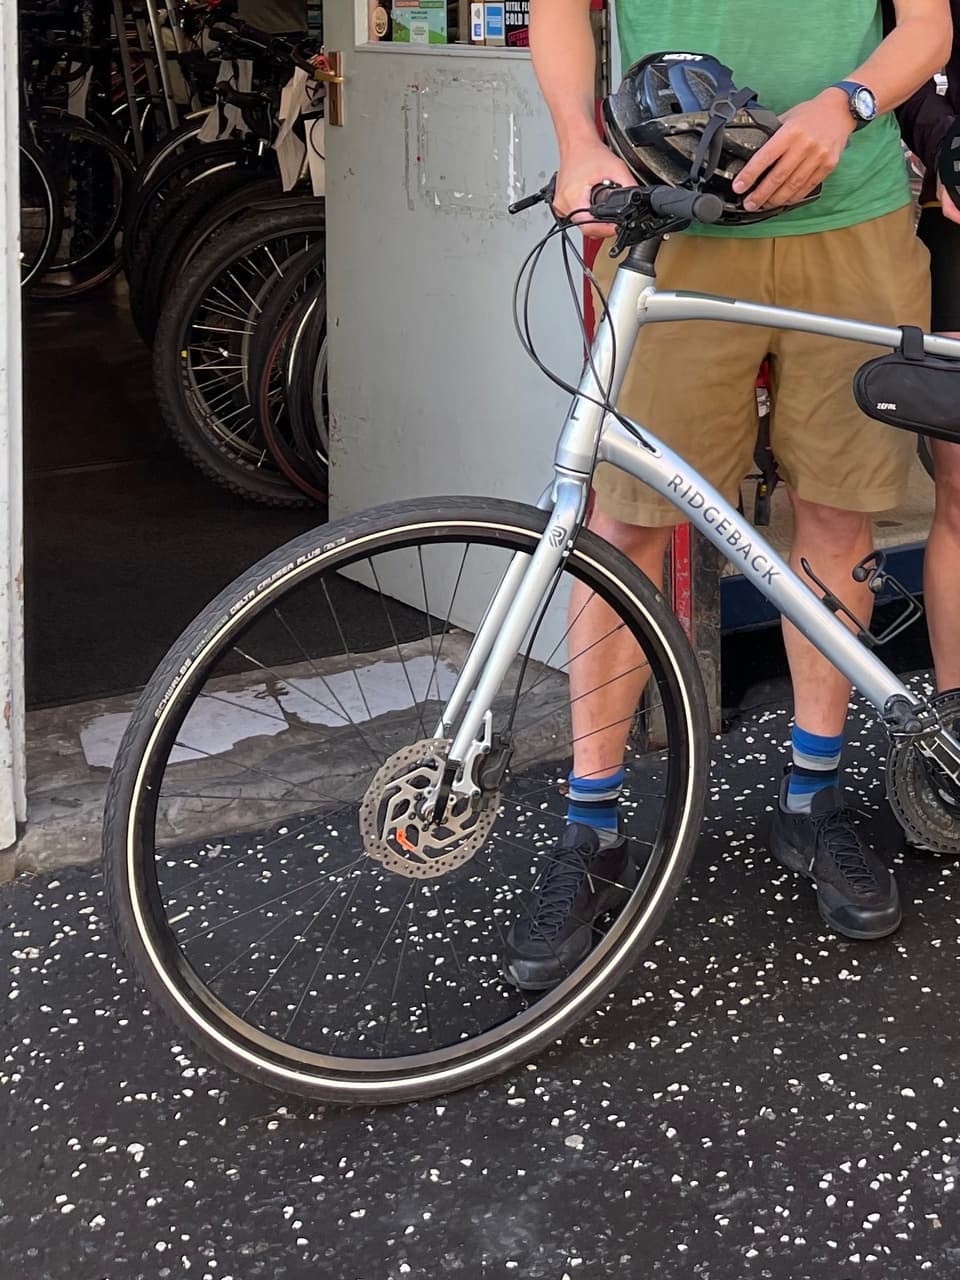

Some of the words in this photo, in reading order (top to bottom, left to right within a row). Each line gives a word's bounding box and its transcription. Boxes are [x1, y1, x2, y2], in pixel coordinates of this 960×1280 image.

[667, 473, 781, 585] RIDGEBACK
[154, 657, 193, 719] SCHWALBE
[229, 590, 256, 616] DELTA
[257, 562, 294, 591] CRUISER
[296, 547, 321, 565] PLUS
